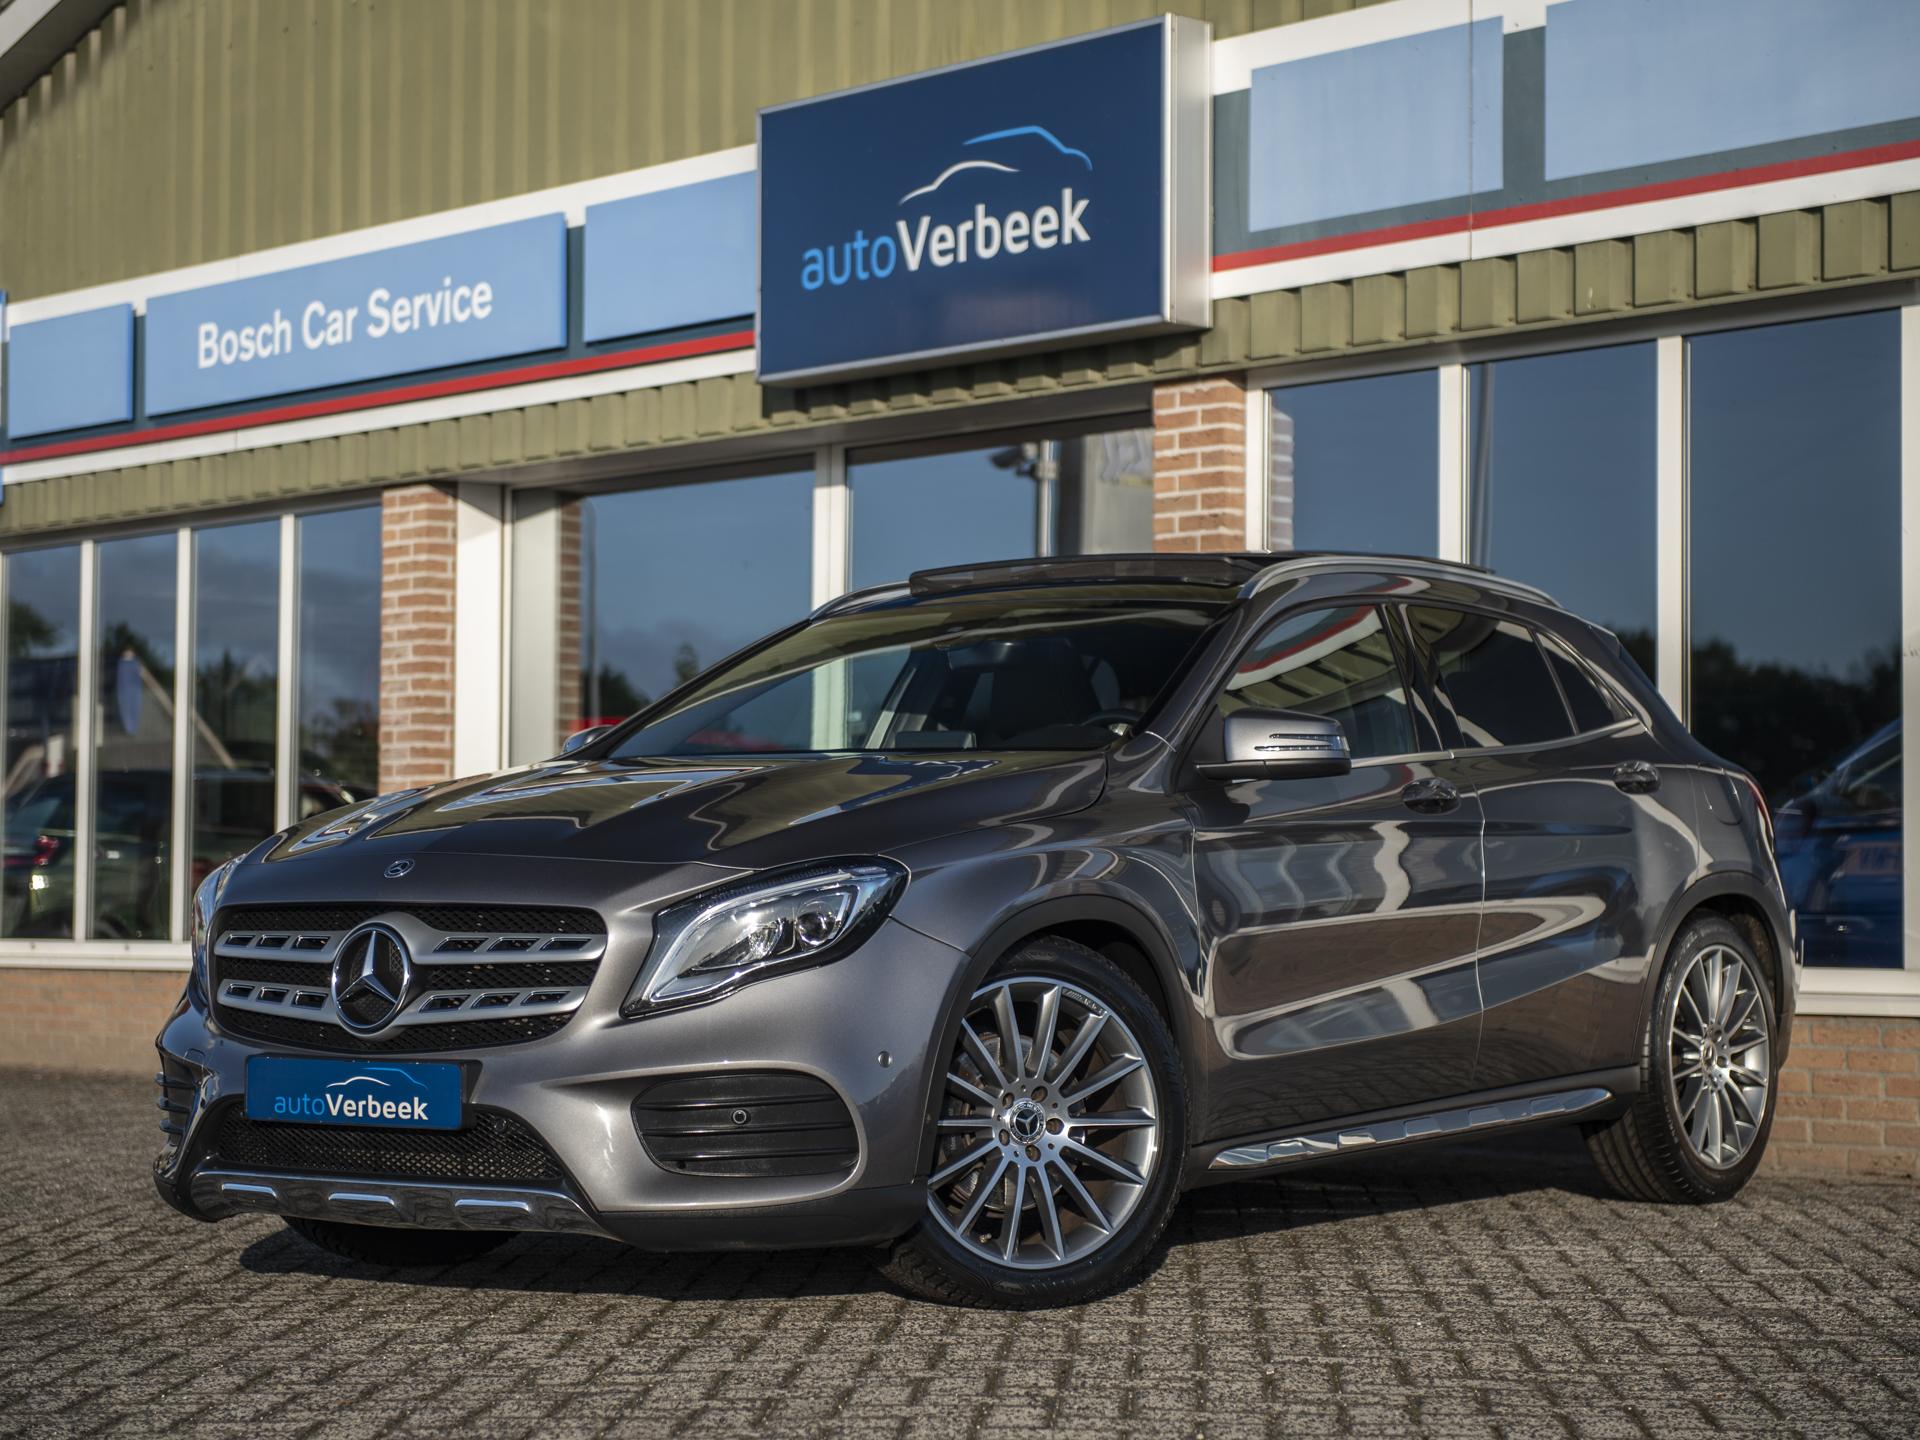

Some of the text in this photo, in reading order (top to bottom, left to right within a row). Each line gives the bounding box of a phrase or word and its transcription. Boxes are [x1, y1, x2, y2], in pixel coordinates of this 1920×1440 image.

[801, 188, 1091, 290] autoVerbeek
[198, 277, 492, 369] Bosch Car Service
[274, 1093, 429, 1121] autoVerbeek
